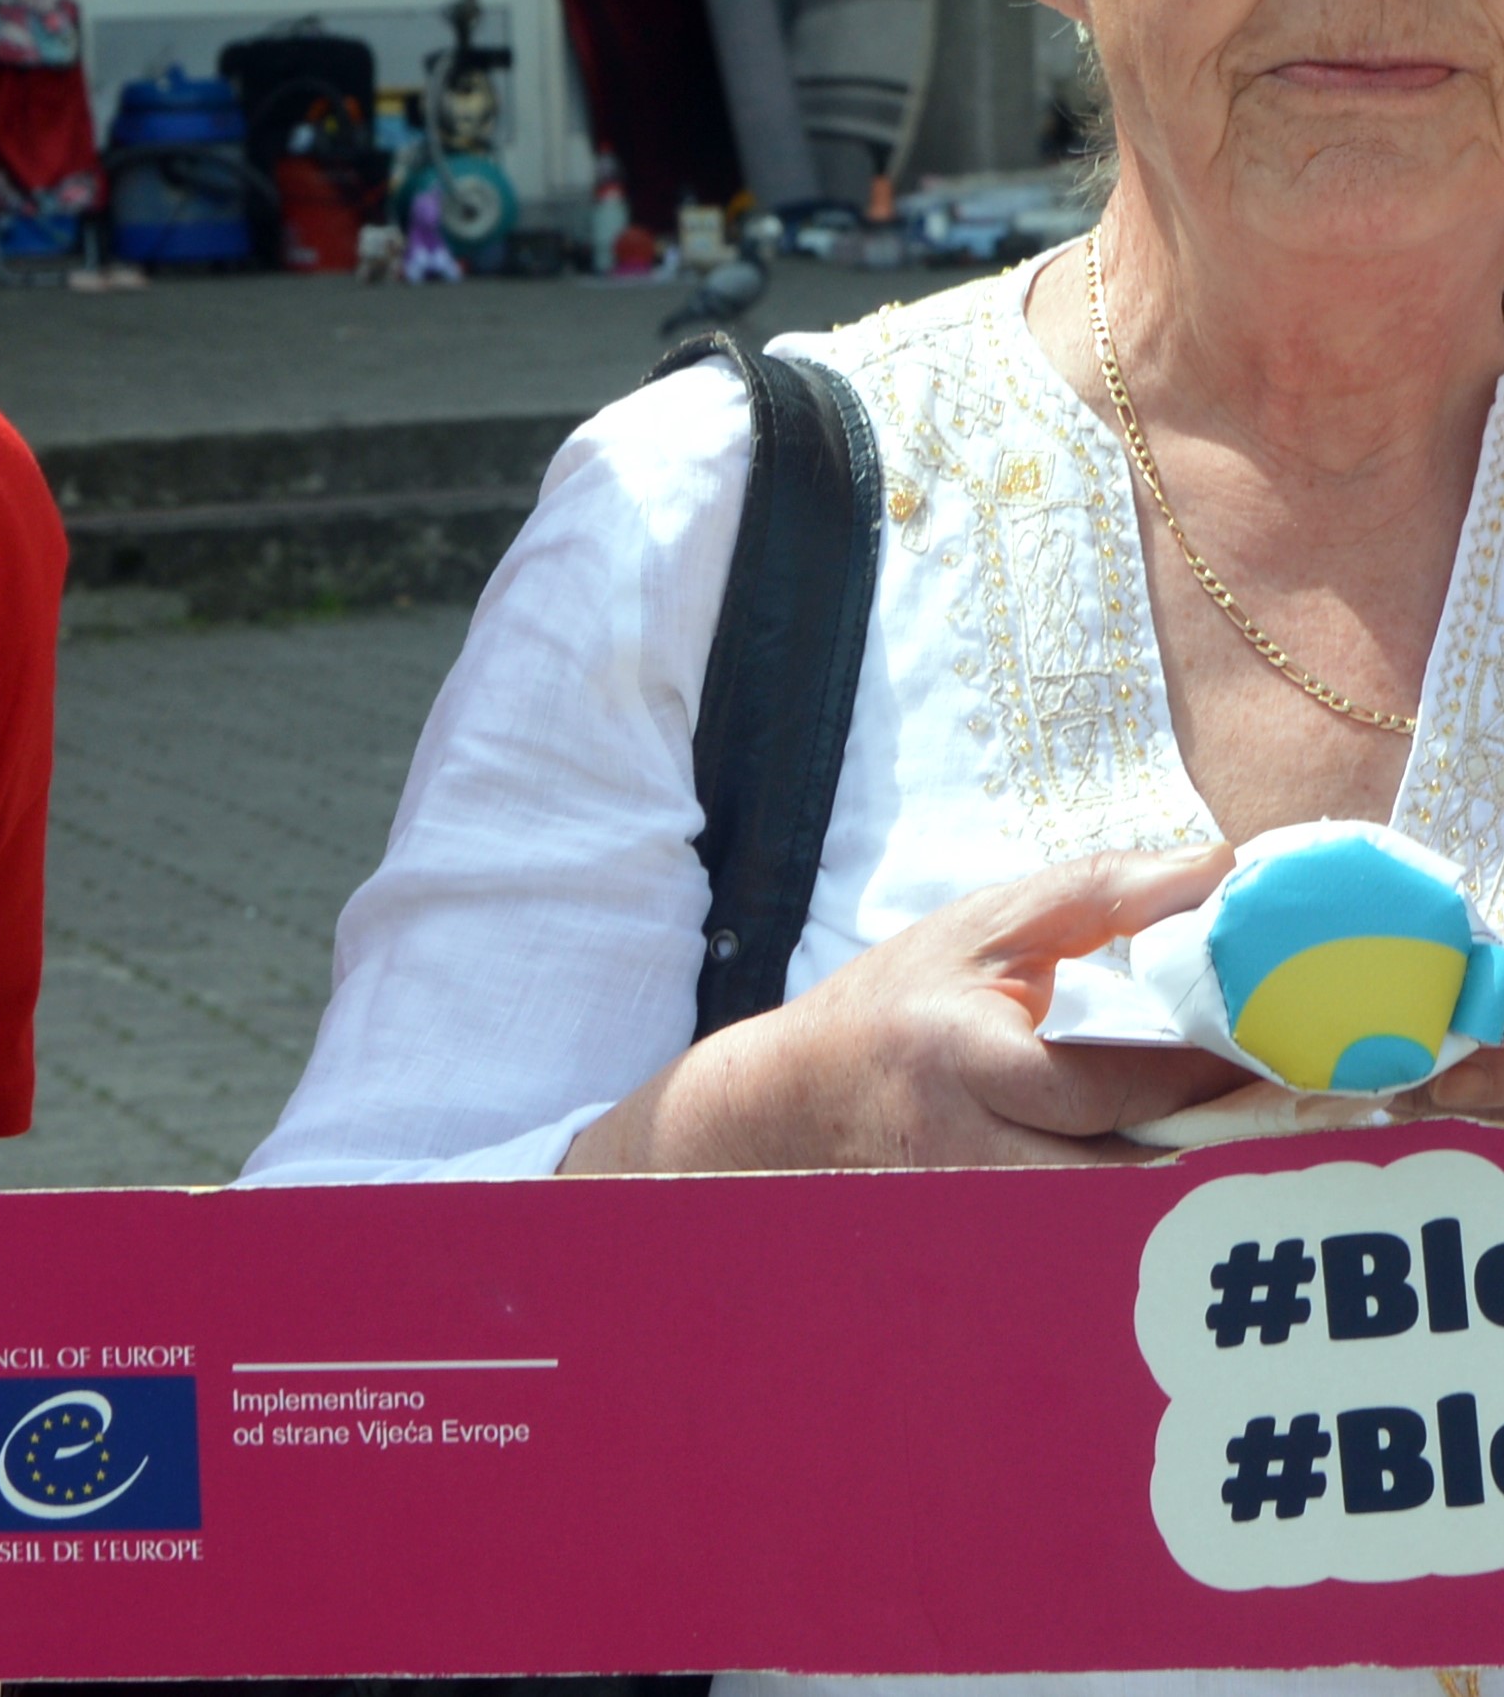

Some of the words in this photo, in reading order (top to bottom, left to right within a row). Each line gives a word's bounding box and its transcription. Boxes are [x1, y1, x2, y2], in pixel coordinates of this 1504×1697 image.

[57, 1347, 91, 1368] OF
[102, 1345, 196, 1368] EUROPE
[232, 1387, 425, 1416] Implementirano
[232, 1422, 264, 1445] od
[272, 1422, 350, 1446] strane
[357, 1419, 434, 1449] Vijeća
[441, 1419, 530, 1447] Evrope
[53, 1540, 84, 1562] DE
[94, 1539, 204, 1562] L'EUROPE
